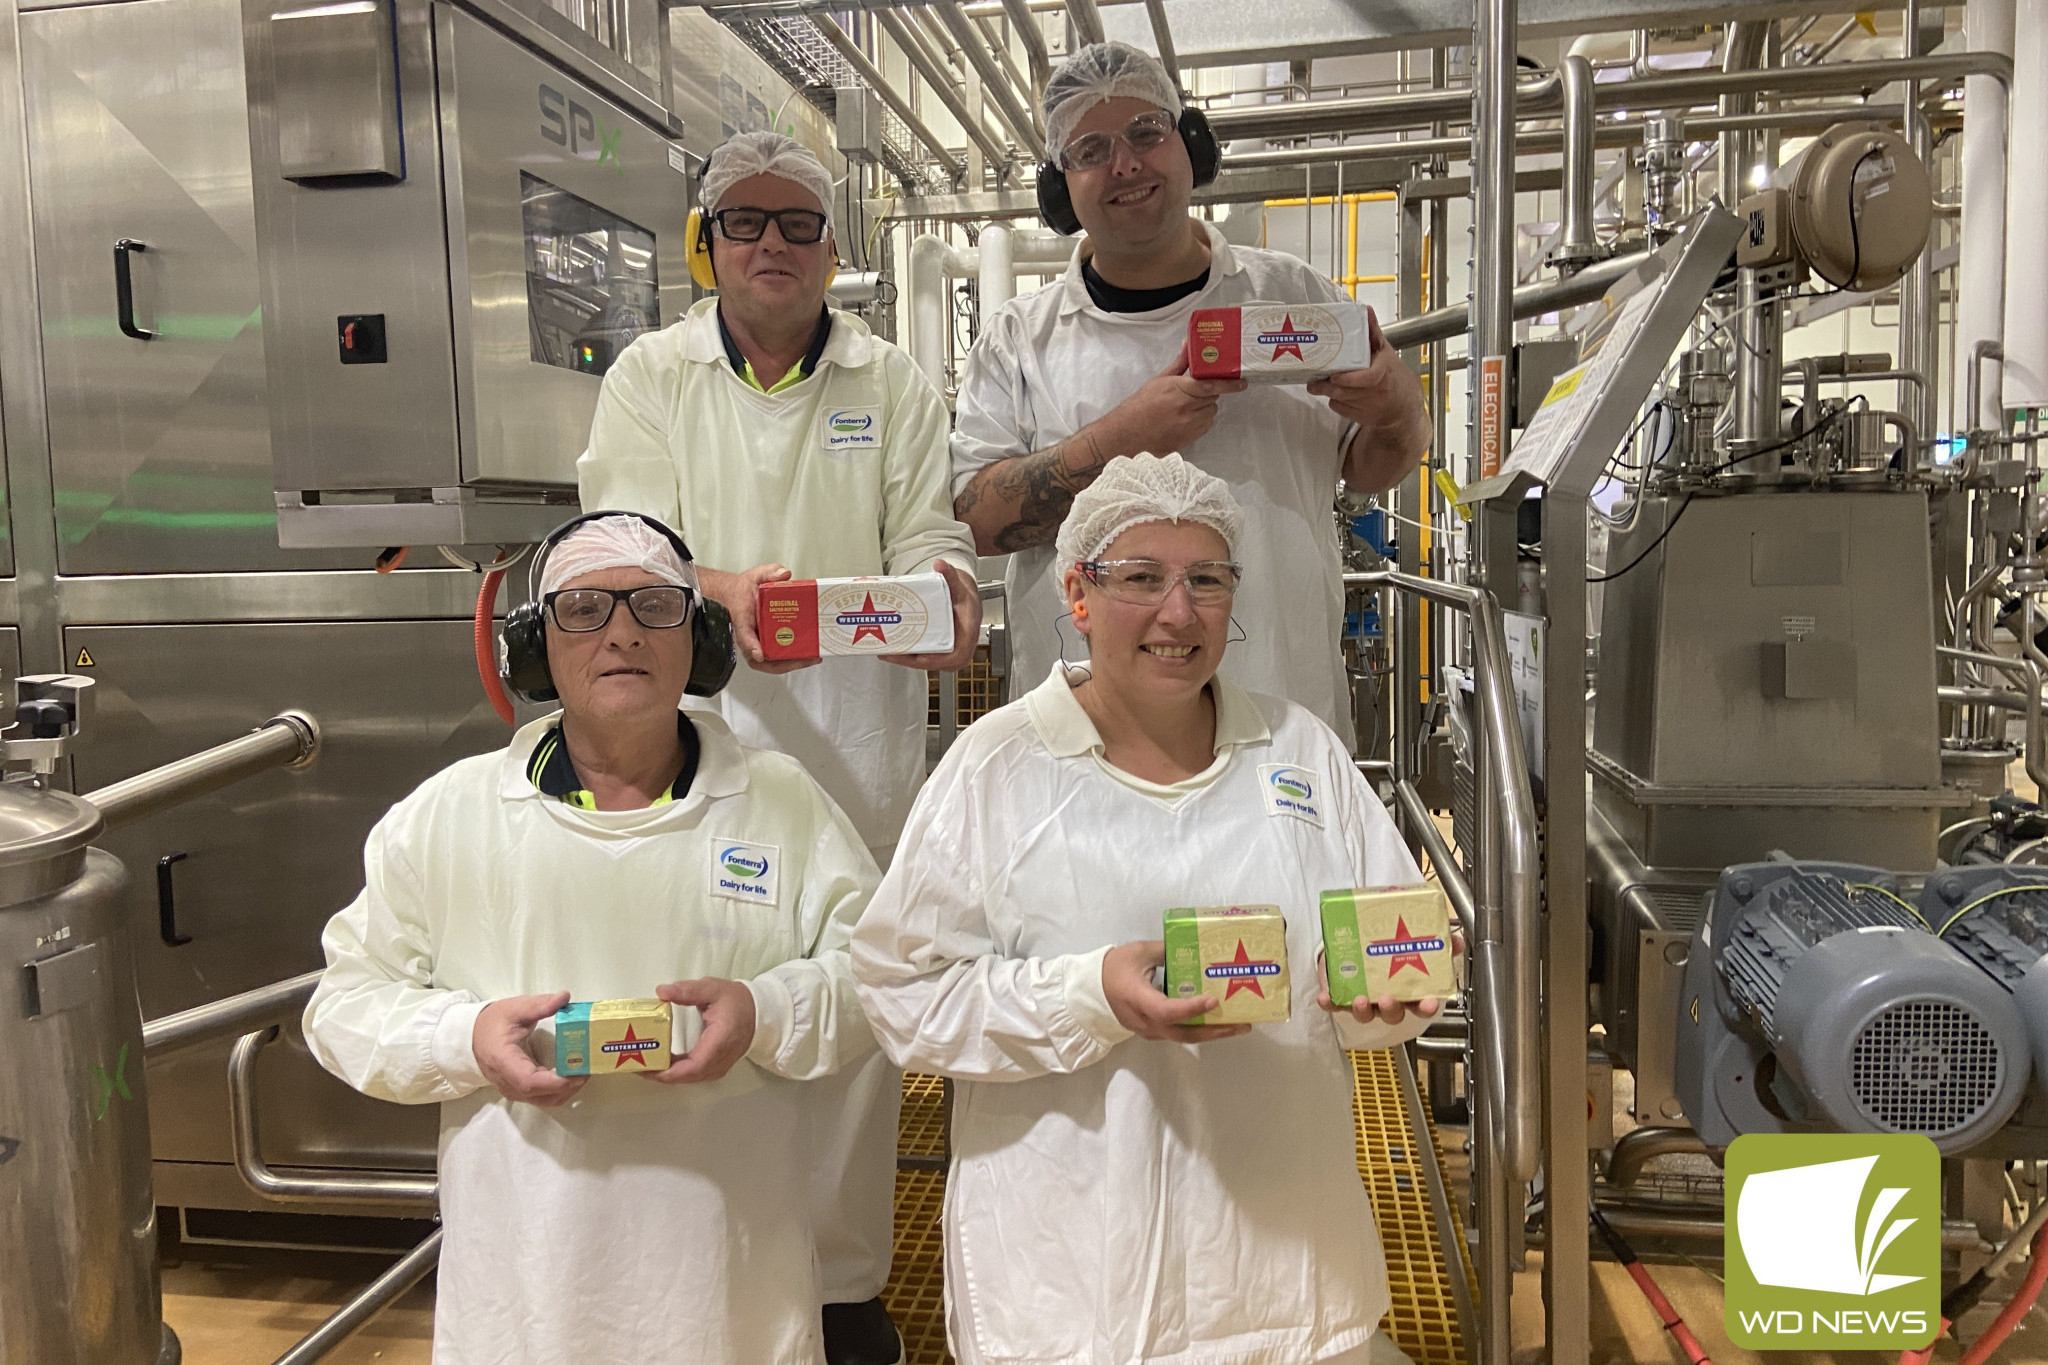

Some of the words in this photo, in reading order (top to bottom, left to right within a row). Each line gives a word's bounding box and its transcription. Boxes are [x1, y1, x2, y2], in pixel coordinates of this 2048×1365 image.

[539, 83, 624, 178] SPX
[1483, 373, 1498, 471] ELECTRICAL
[873, 592, 904, 609] 1926
[838, 616, 876, 624] WESTERN
[1275, 799, 1296, 811] Dairy
[1296, 803, 1307, 812] for
[728, 855, 762, 869] Fonterra
[720, 879, 741, 892] Dairy
[741, 883, 754, 892] for
[754, 885, 767, 895] life
[1369, 942, 1413, 954] WESTERN
[1416, 940, 1441, 950] STAR
[1208, 966, 1251, 976] WESTERN
[1253, 965, 1277, 974] STAR
[603, 1043, 637, 1052] WESTERN
[639, 1042, 657, 1050] STAR
